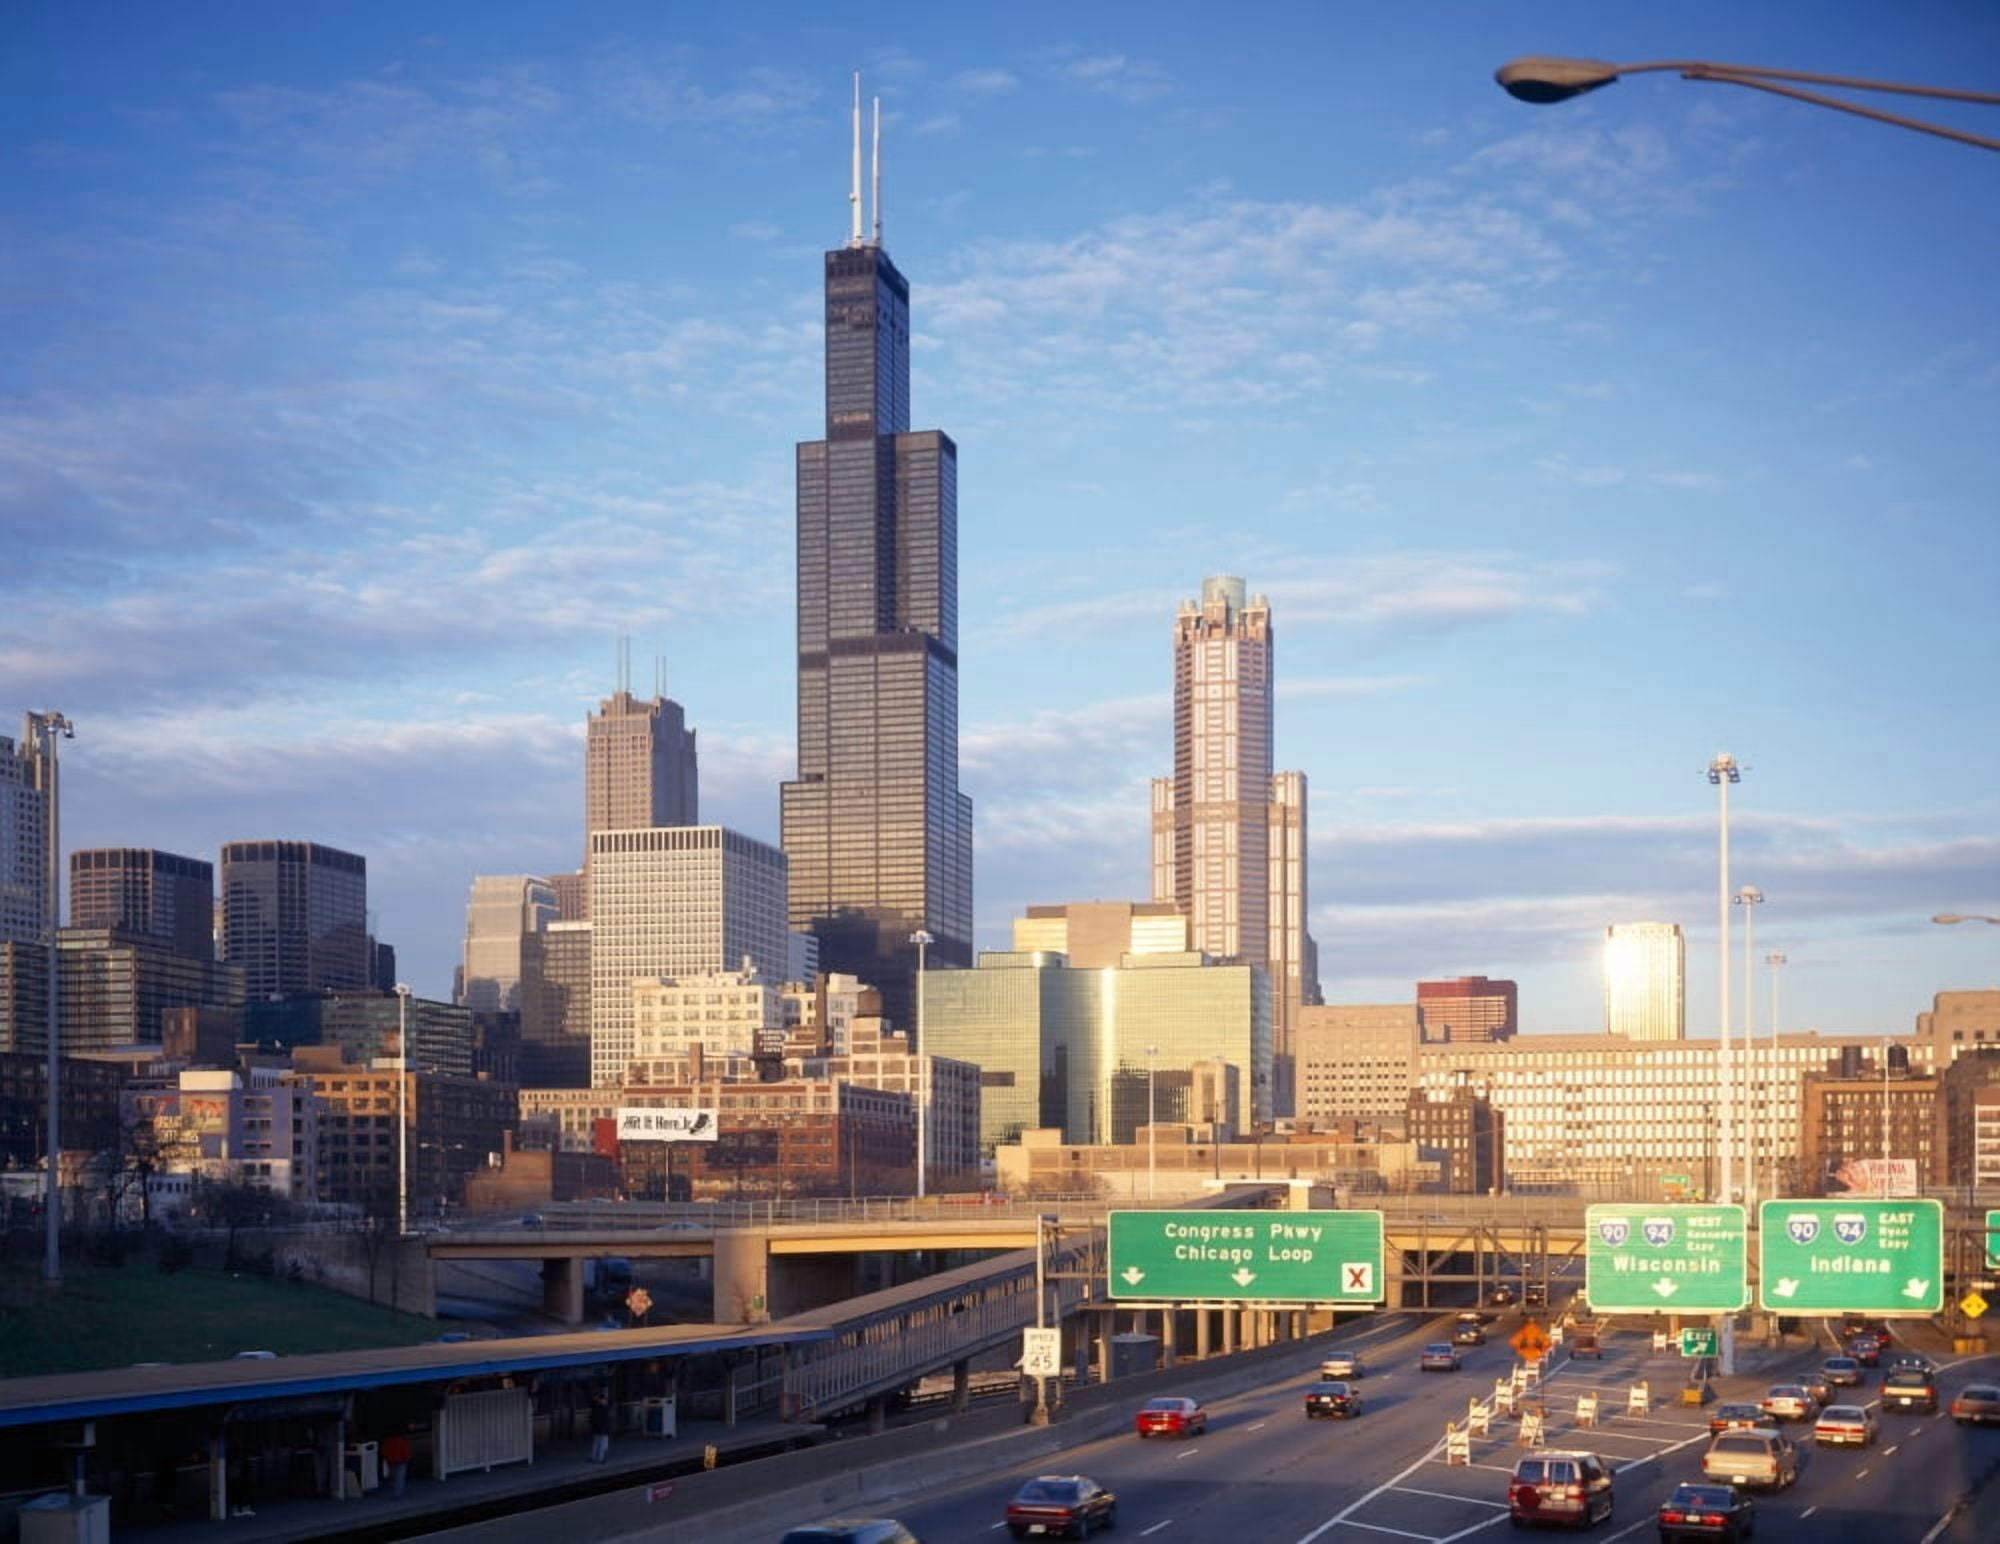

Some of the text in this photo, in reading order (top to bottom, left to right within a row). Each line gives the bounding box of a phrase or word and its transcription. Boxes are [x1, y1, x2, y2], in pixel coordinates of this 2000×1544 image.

[1879, 1212, 1914, 1225] EAST
[1164, 1223, 1323, 1243] Congress Pkwy
[1602, 1225, 1625, 1239] 90
[1647, 1225, 1669, 1240] 94
[1791, 1222, 1814, 1238] 90
[1838, 1222, 1861, 1238] 94
[1175, 1245, 1313, 1264] Chicago Loop
[1613, 1255, 1721, 1273] Wisconsin
[1810, 1255, 1891, 1274] Indiana
[1030, 1355, 1053, 1371] 45
